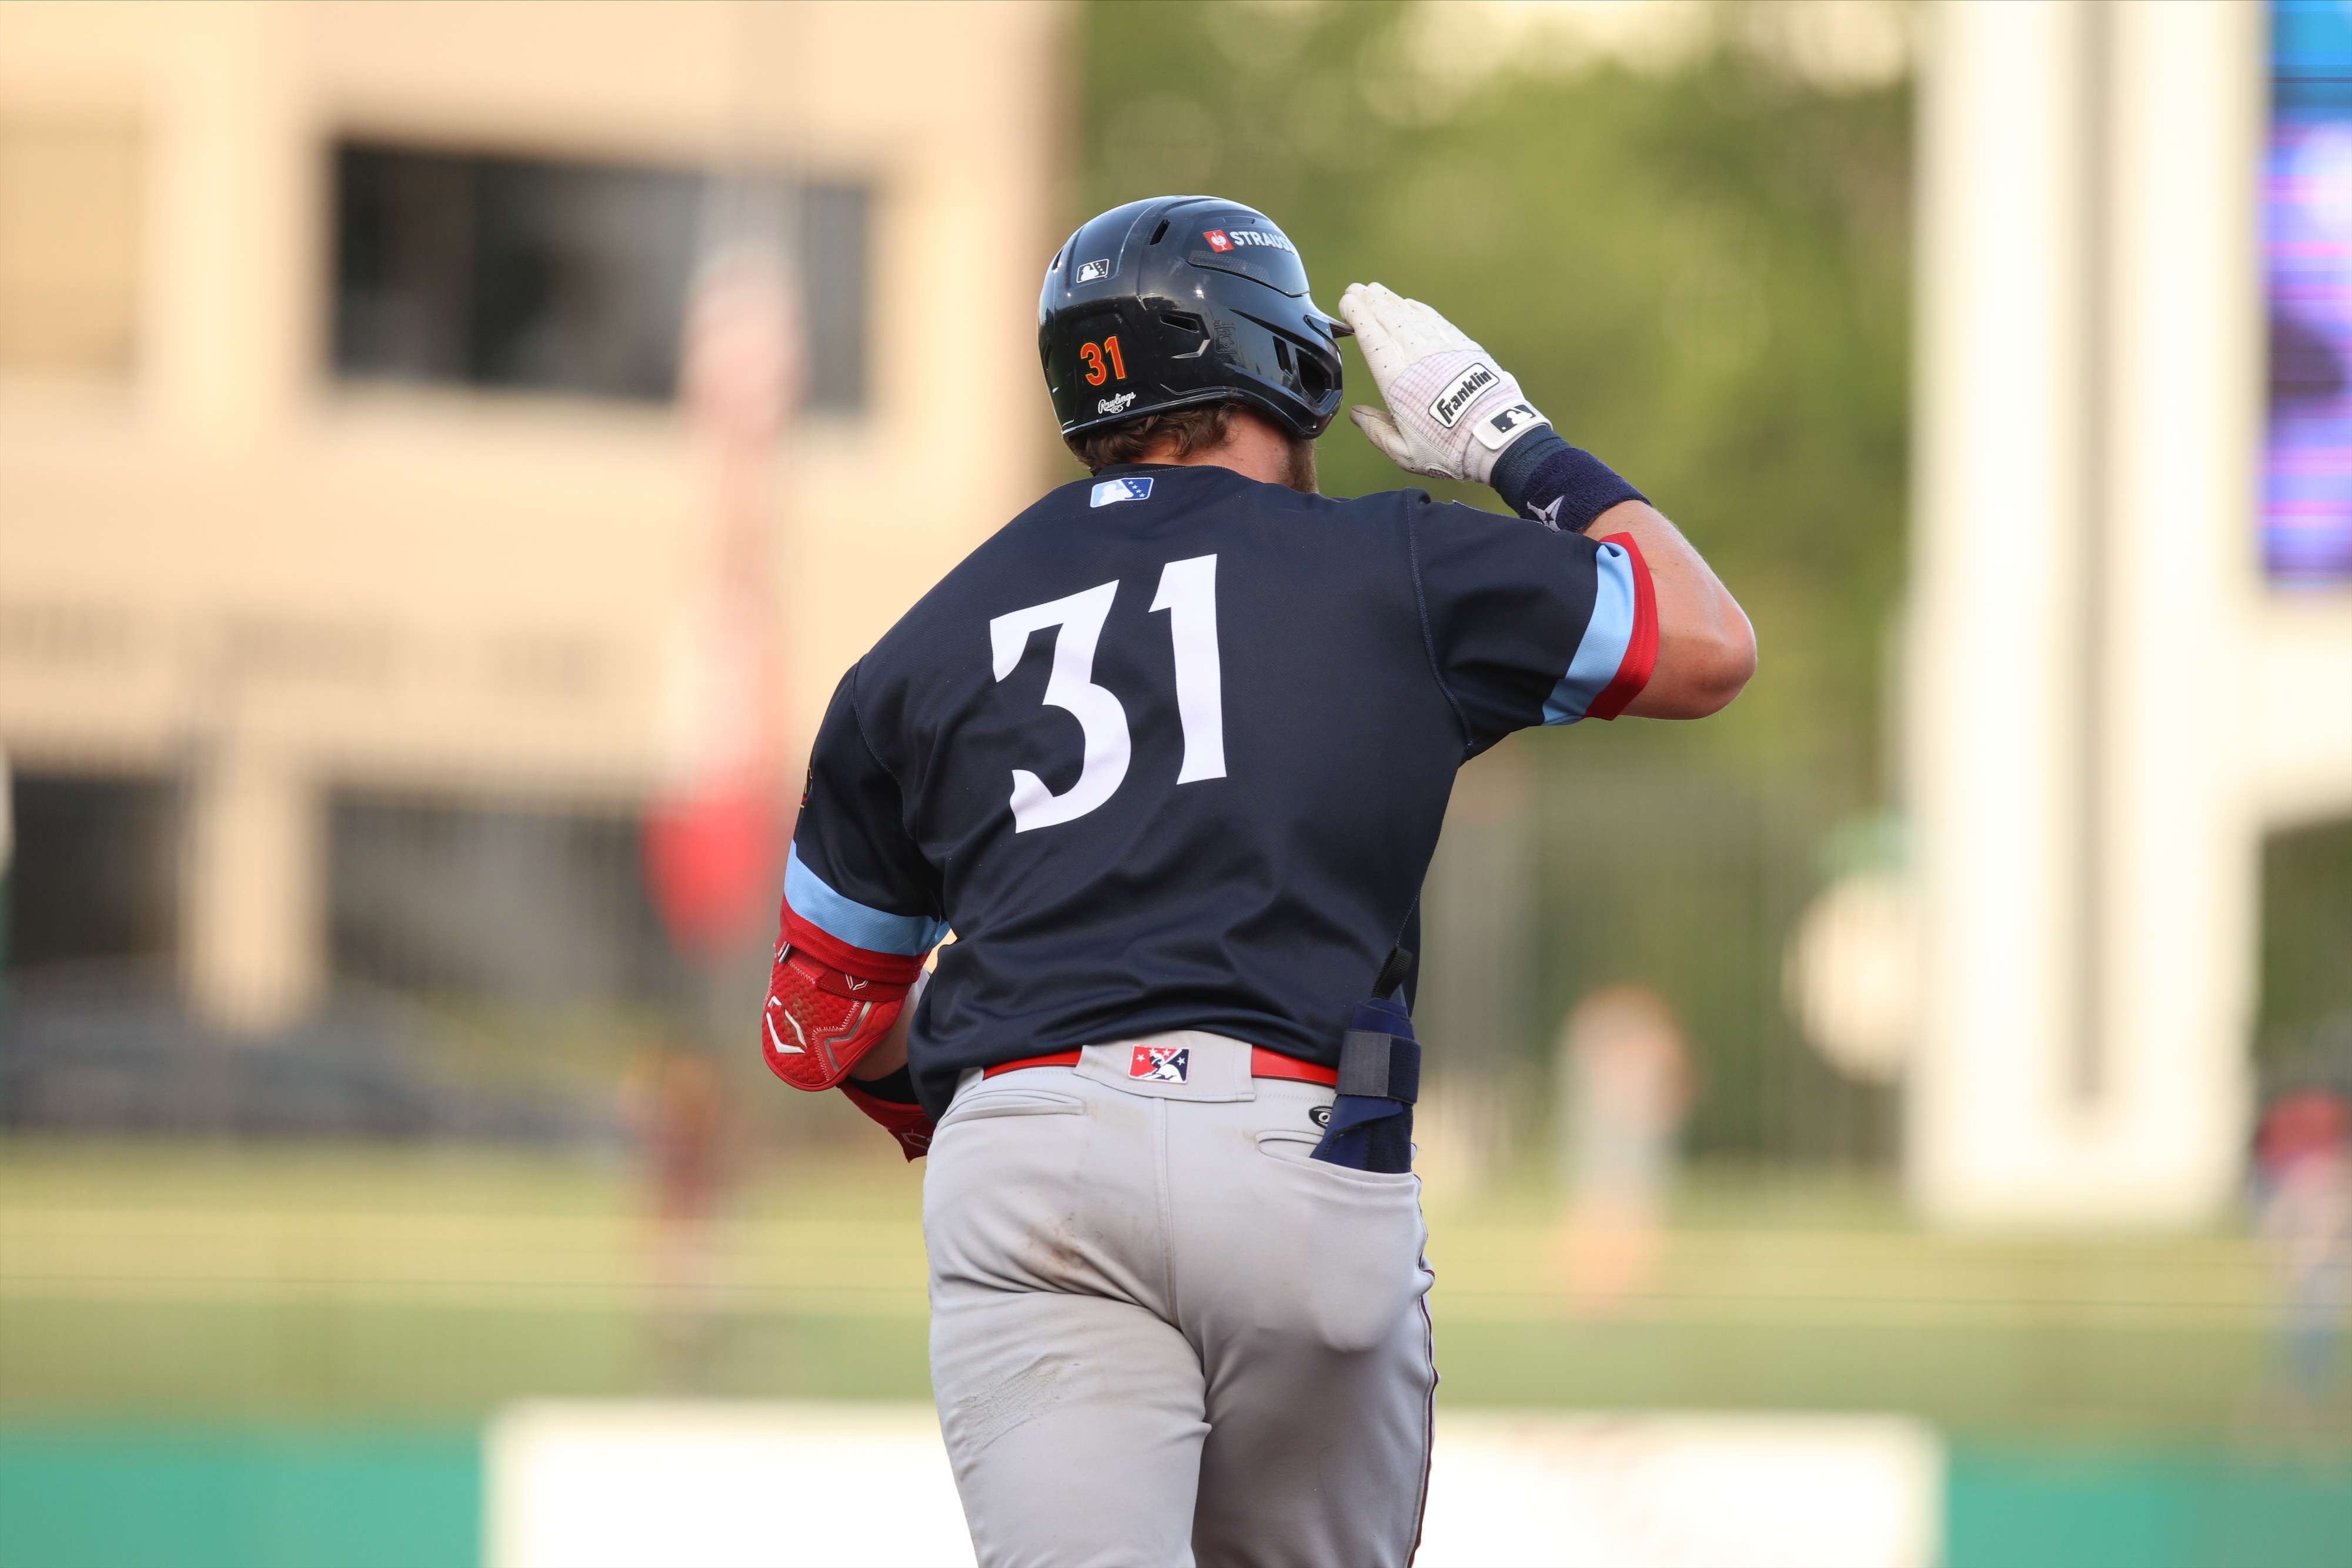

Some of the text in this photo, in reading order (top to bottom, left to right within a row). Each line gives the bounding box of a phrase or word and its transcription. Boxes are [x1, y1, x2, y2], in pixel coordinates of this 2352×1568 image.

[1080, 336, 1126, 386] 31
[1098, 392, 1136, 414] Rawlings
[1436, 371, 1492, 424] Franklin
[990, 554, 1227, 833] 31
